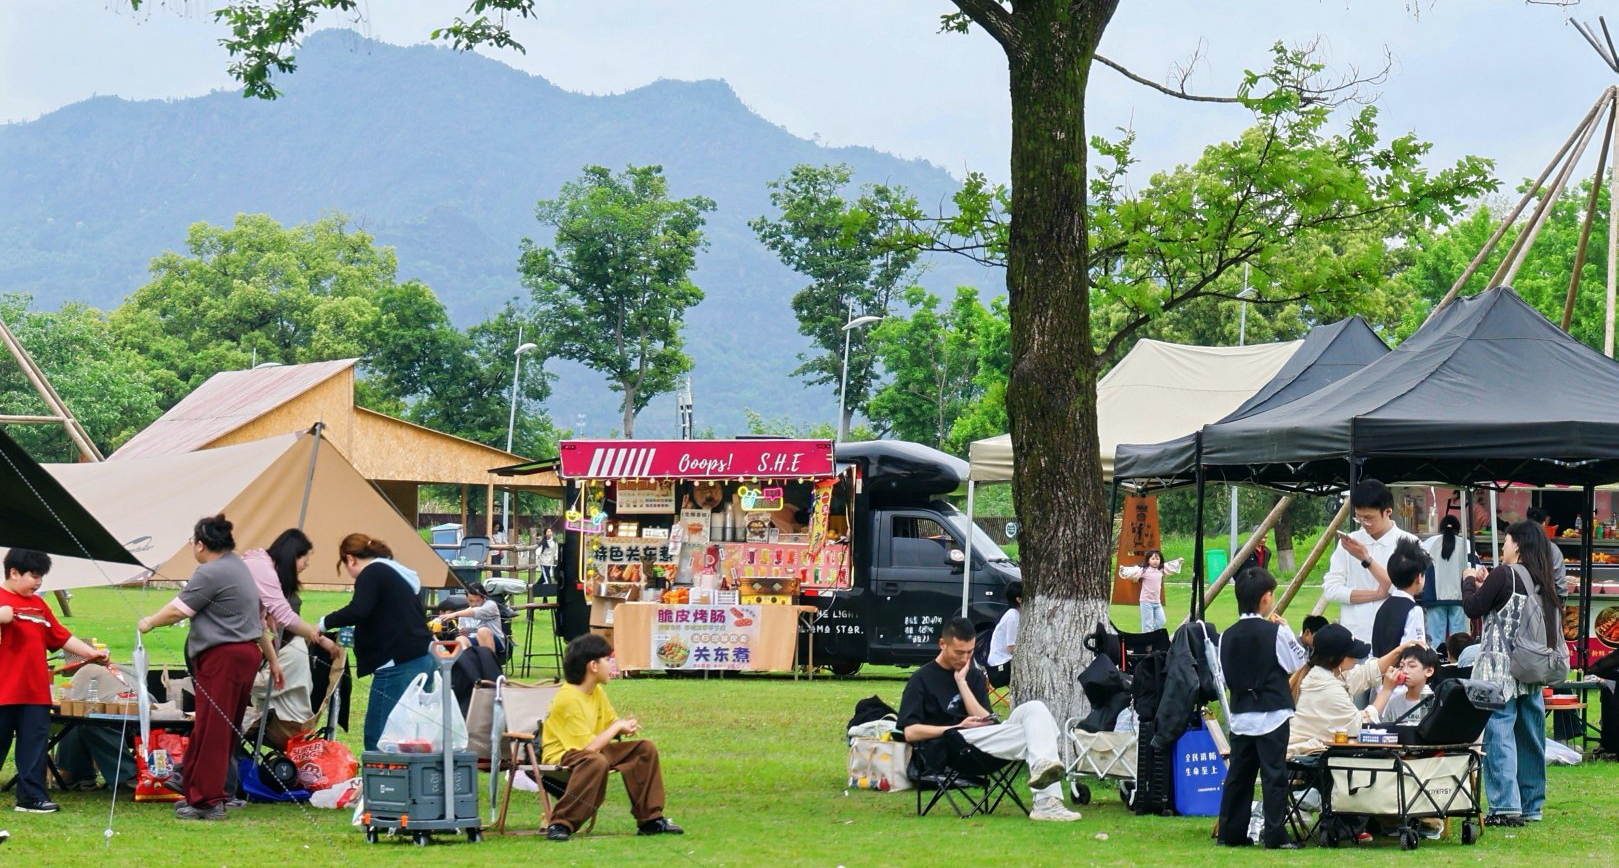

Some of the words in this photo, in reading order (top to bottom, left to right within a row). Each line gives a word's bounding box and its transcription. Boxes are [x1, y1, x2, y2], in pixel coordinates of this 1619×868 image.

[757, 452, 805, 473] S.H.E
[594, 546, 673, 562] 特色关东煮
[657, 608, 726, 624] 脆皮烤肠
[694, 646, 750, 662] 关东煮
[1185, 751, 1217, 763] 全民消防
[1185, 765, 1219, 777] 生命至上
